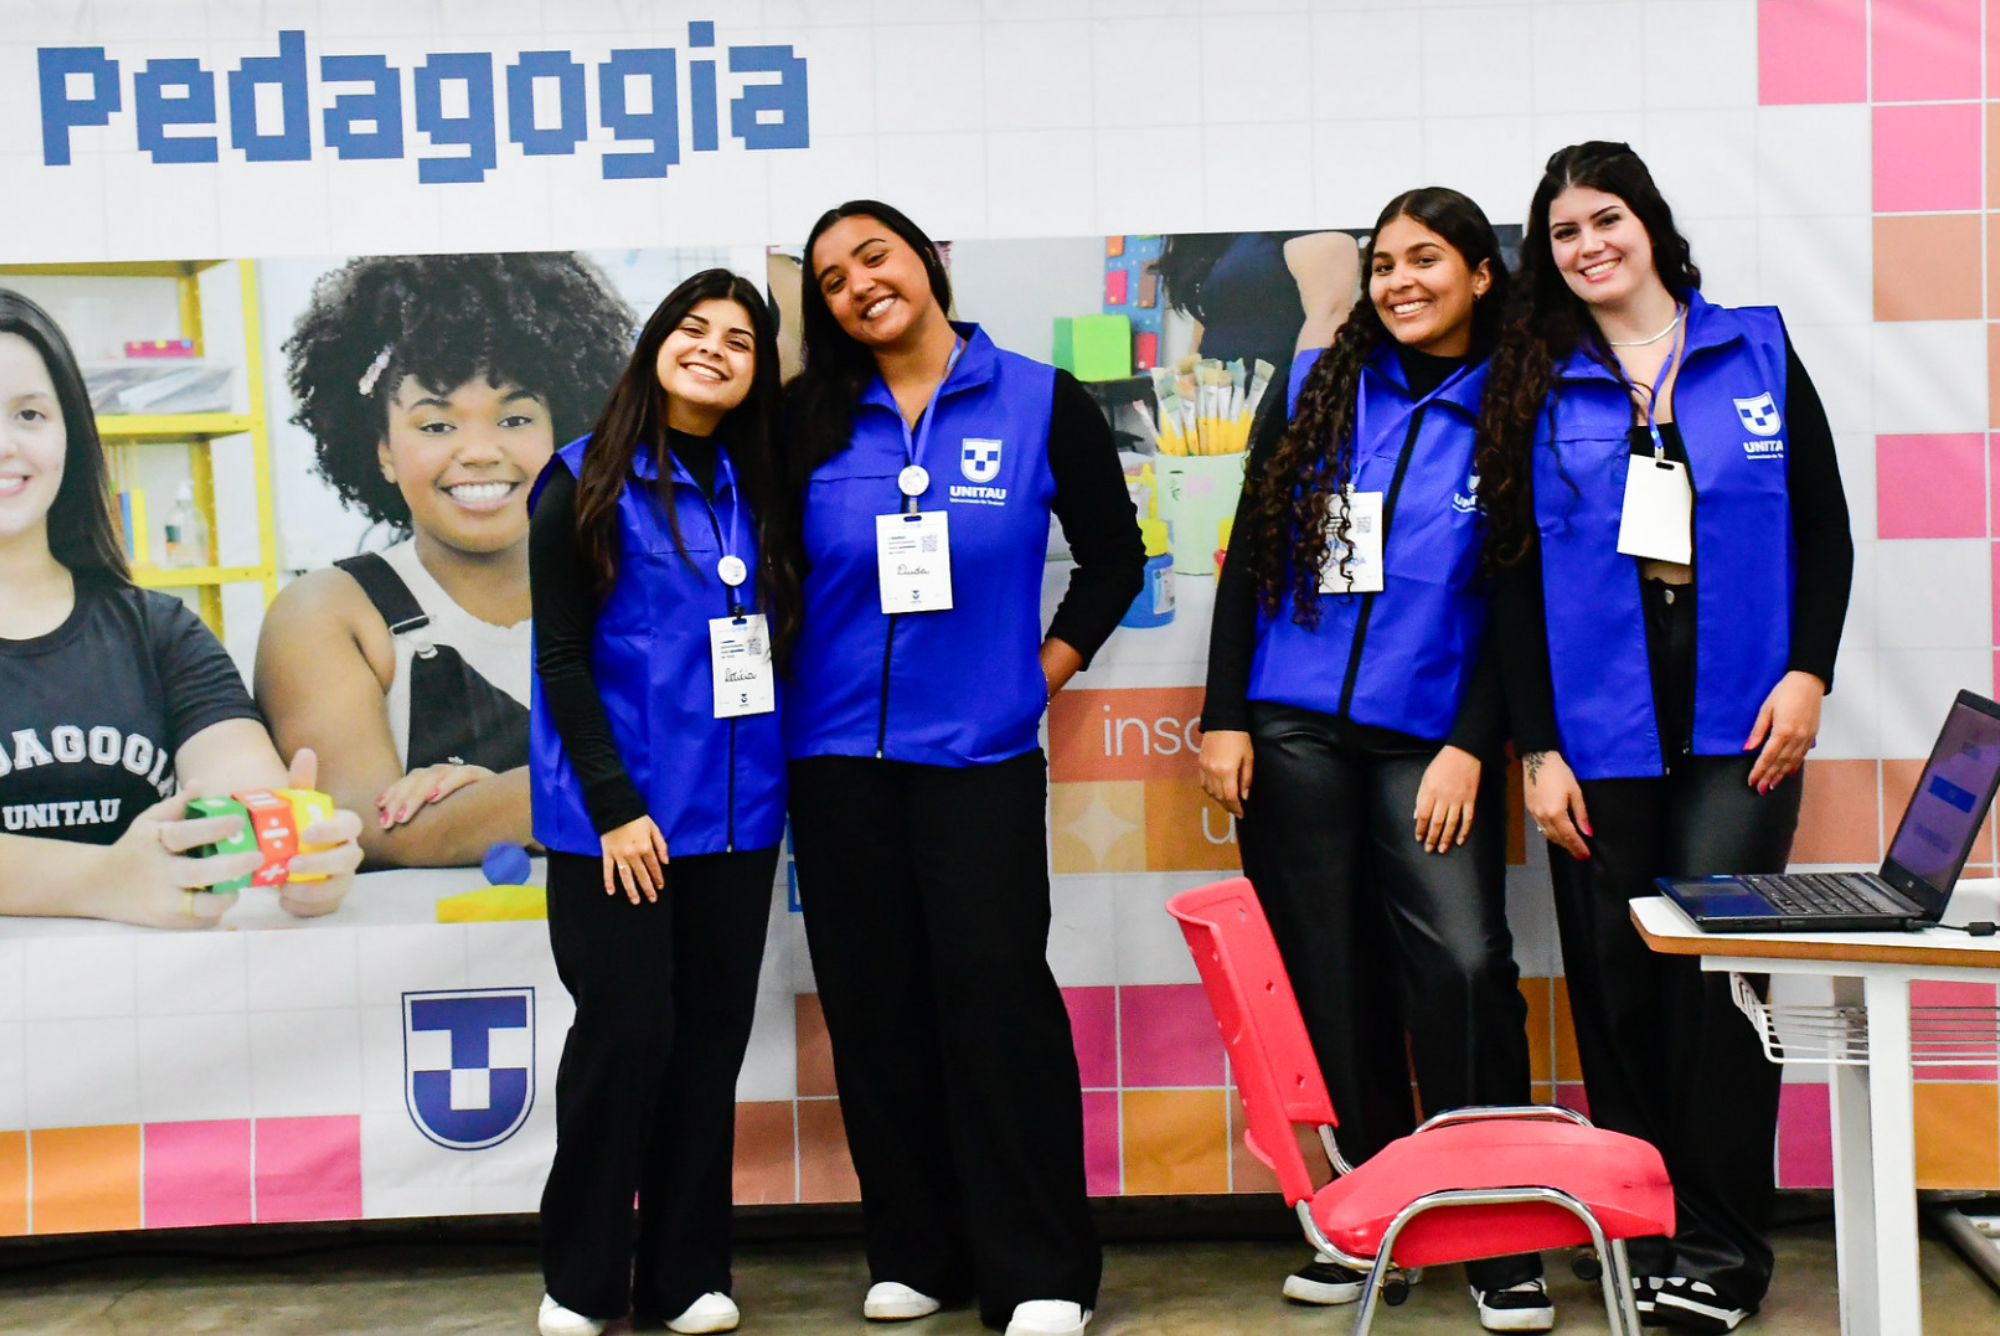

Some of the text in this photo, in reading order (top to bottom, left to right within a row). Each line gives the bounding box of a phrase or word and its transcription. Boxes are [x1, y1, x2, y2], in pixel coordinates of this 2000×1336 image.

[37, 20, 810, 184] Pedagogia
[1743, 439, 1784, 453] UNITA
[949, 485, 1007, 500] UNITAU
[2, 798, 121, 831] UNITAU
